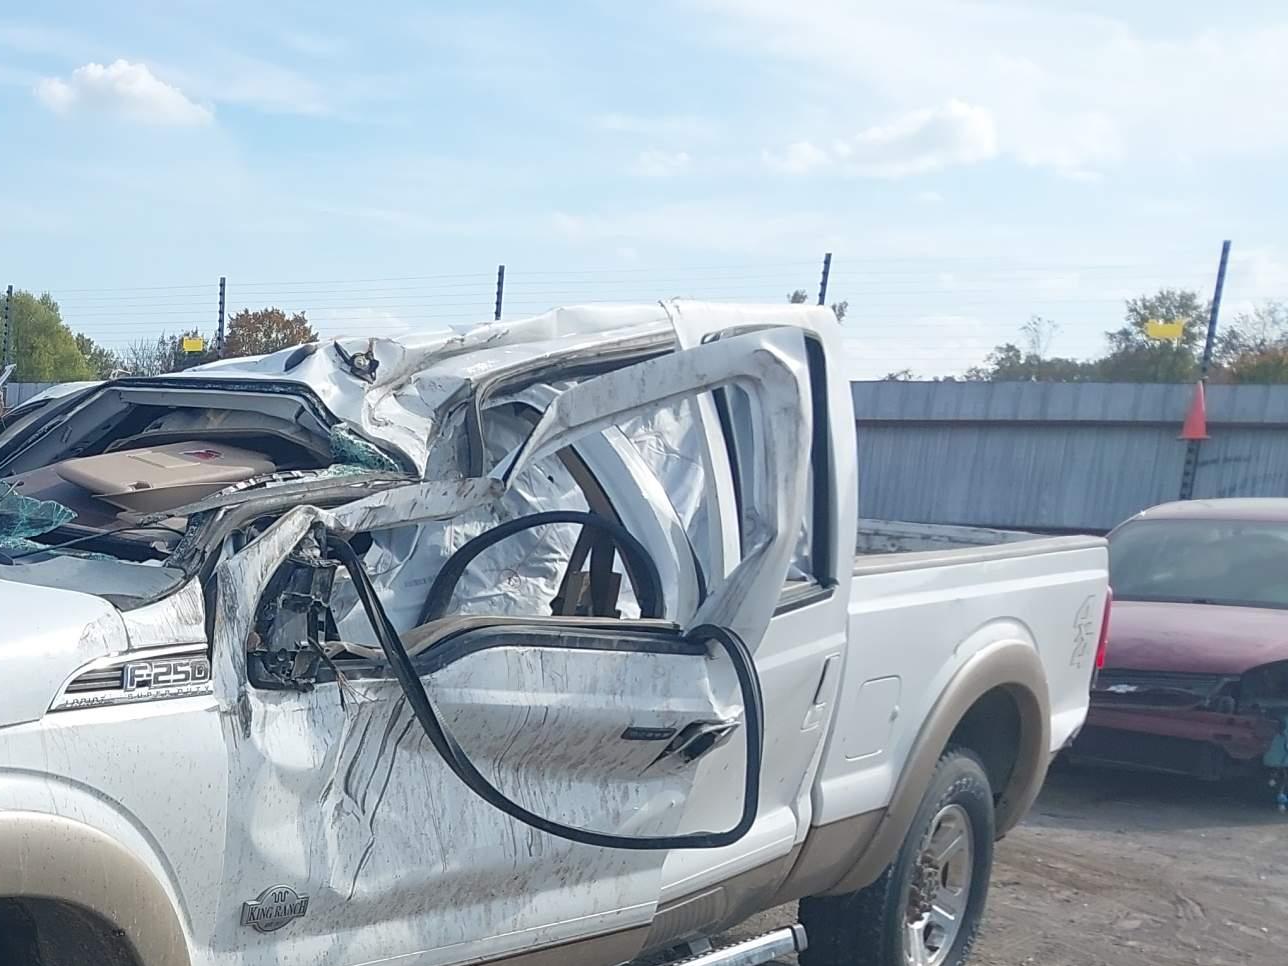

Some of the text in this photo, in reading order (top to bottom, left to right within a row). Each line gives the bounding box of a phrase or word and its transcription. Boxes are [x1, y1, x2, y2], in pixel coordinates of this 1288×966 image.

[123, 659, 210, 692] F-250
[176, 686, 210, 697] DUTY
[249, 899, 306, 921] KING RANCH
